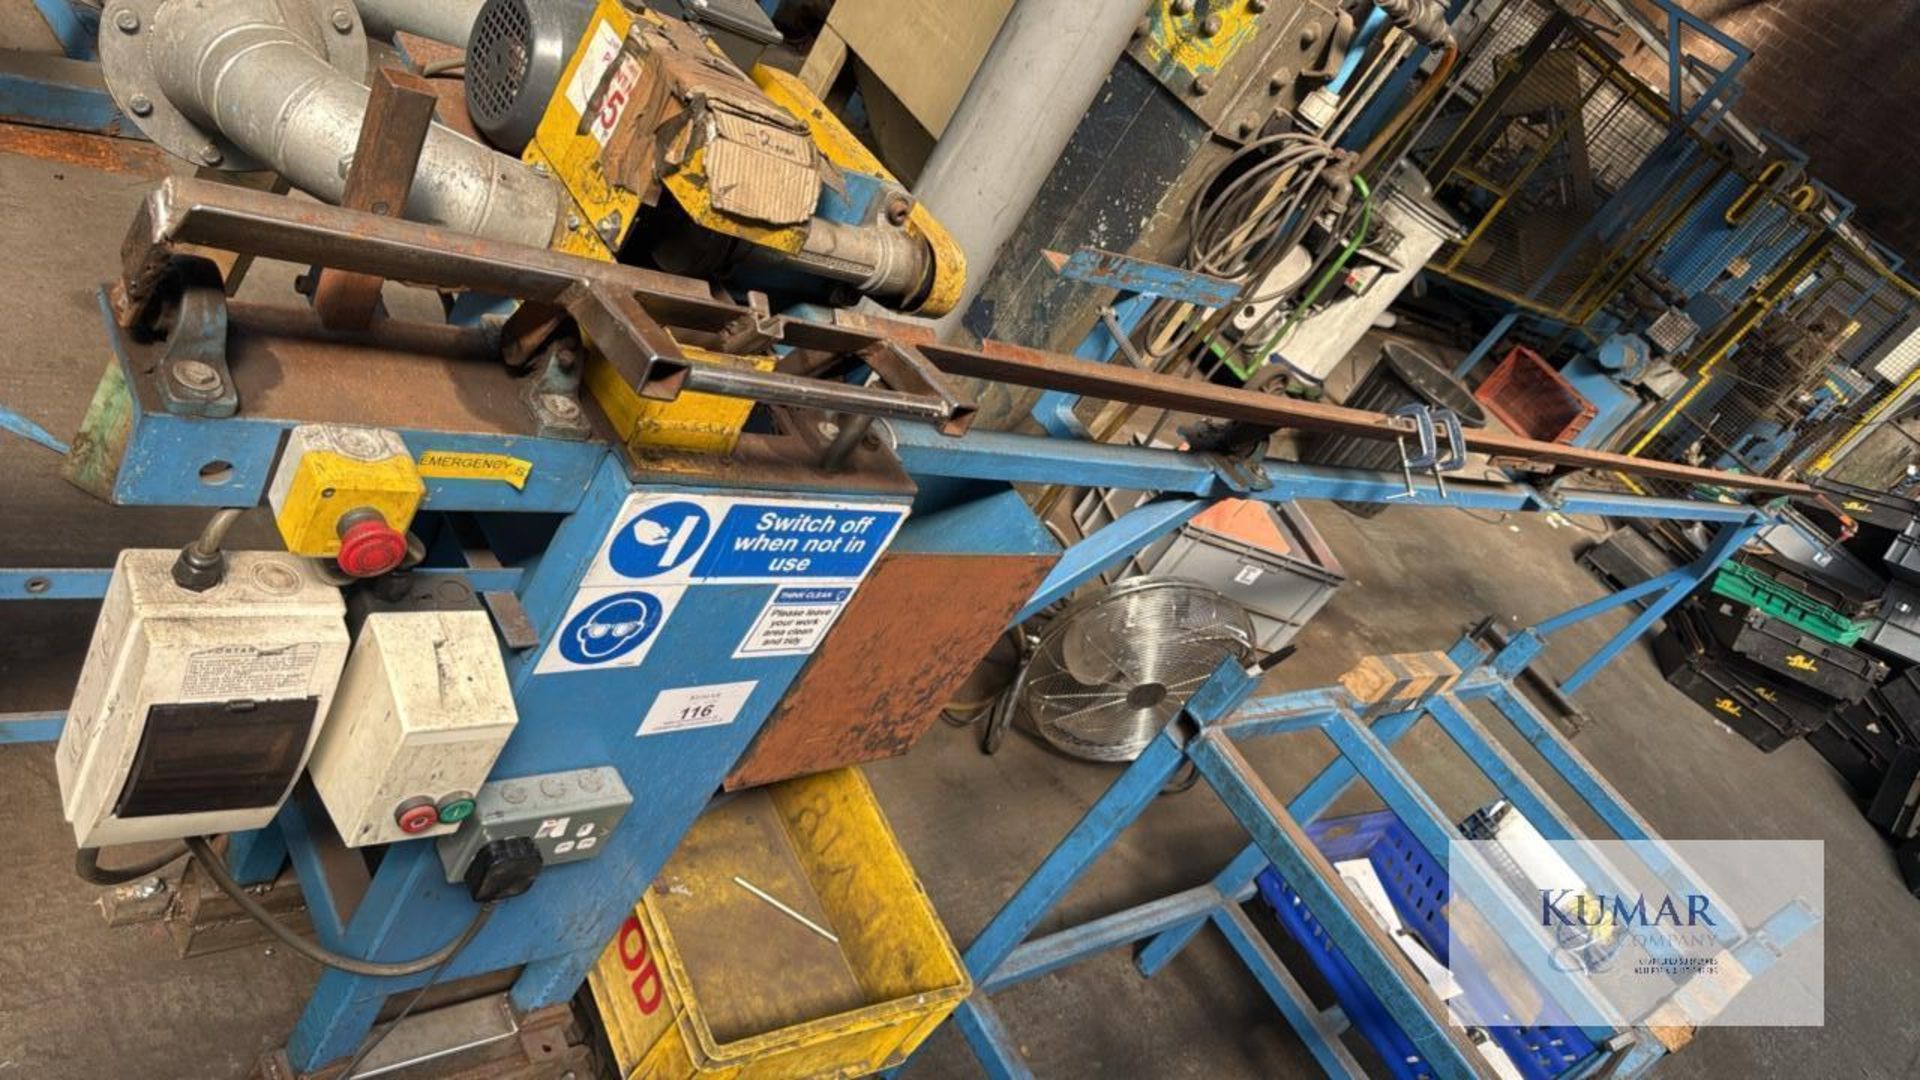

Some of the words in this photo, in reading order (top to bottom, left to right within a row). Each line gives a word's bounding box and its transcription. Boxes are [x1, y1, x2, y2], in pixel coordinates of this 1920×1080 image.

[420, 455, 515, 470] EMERGENCY
[756, 512, 833, 533] Switch
[839, 516, 877, 534] off
[734, 533, 799, 553] when
[802, 537, 844, 553] not
[843, 536, 866, 553] in
[768, 557, 812, 572] use
[770, 608, 805, 618] Please
[806, 608, 832, 617] leave
[769, 618, 795, 628] your
[796, 618, 818, 626] work
[762, 629, 785, 637] area
[787, 628, 814, 636] clean
[762, 637, 782, 646] and
[783, 637, 803, 647] tidy
[680, 703, 715, 720] 116
